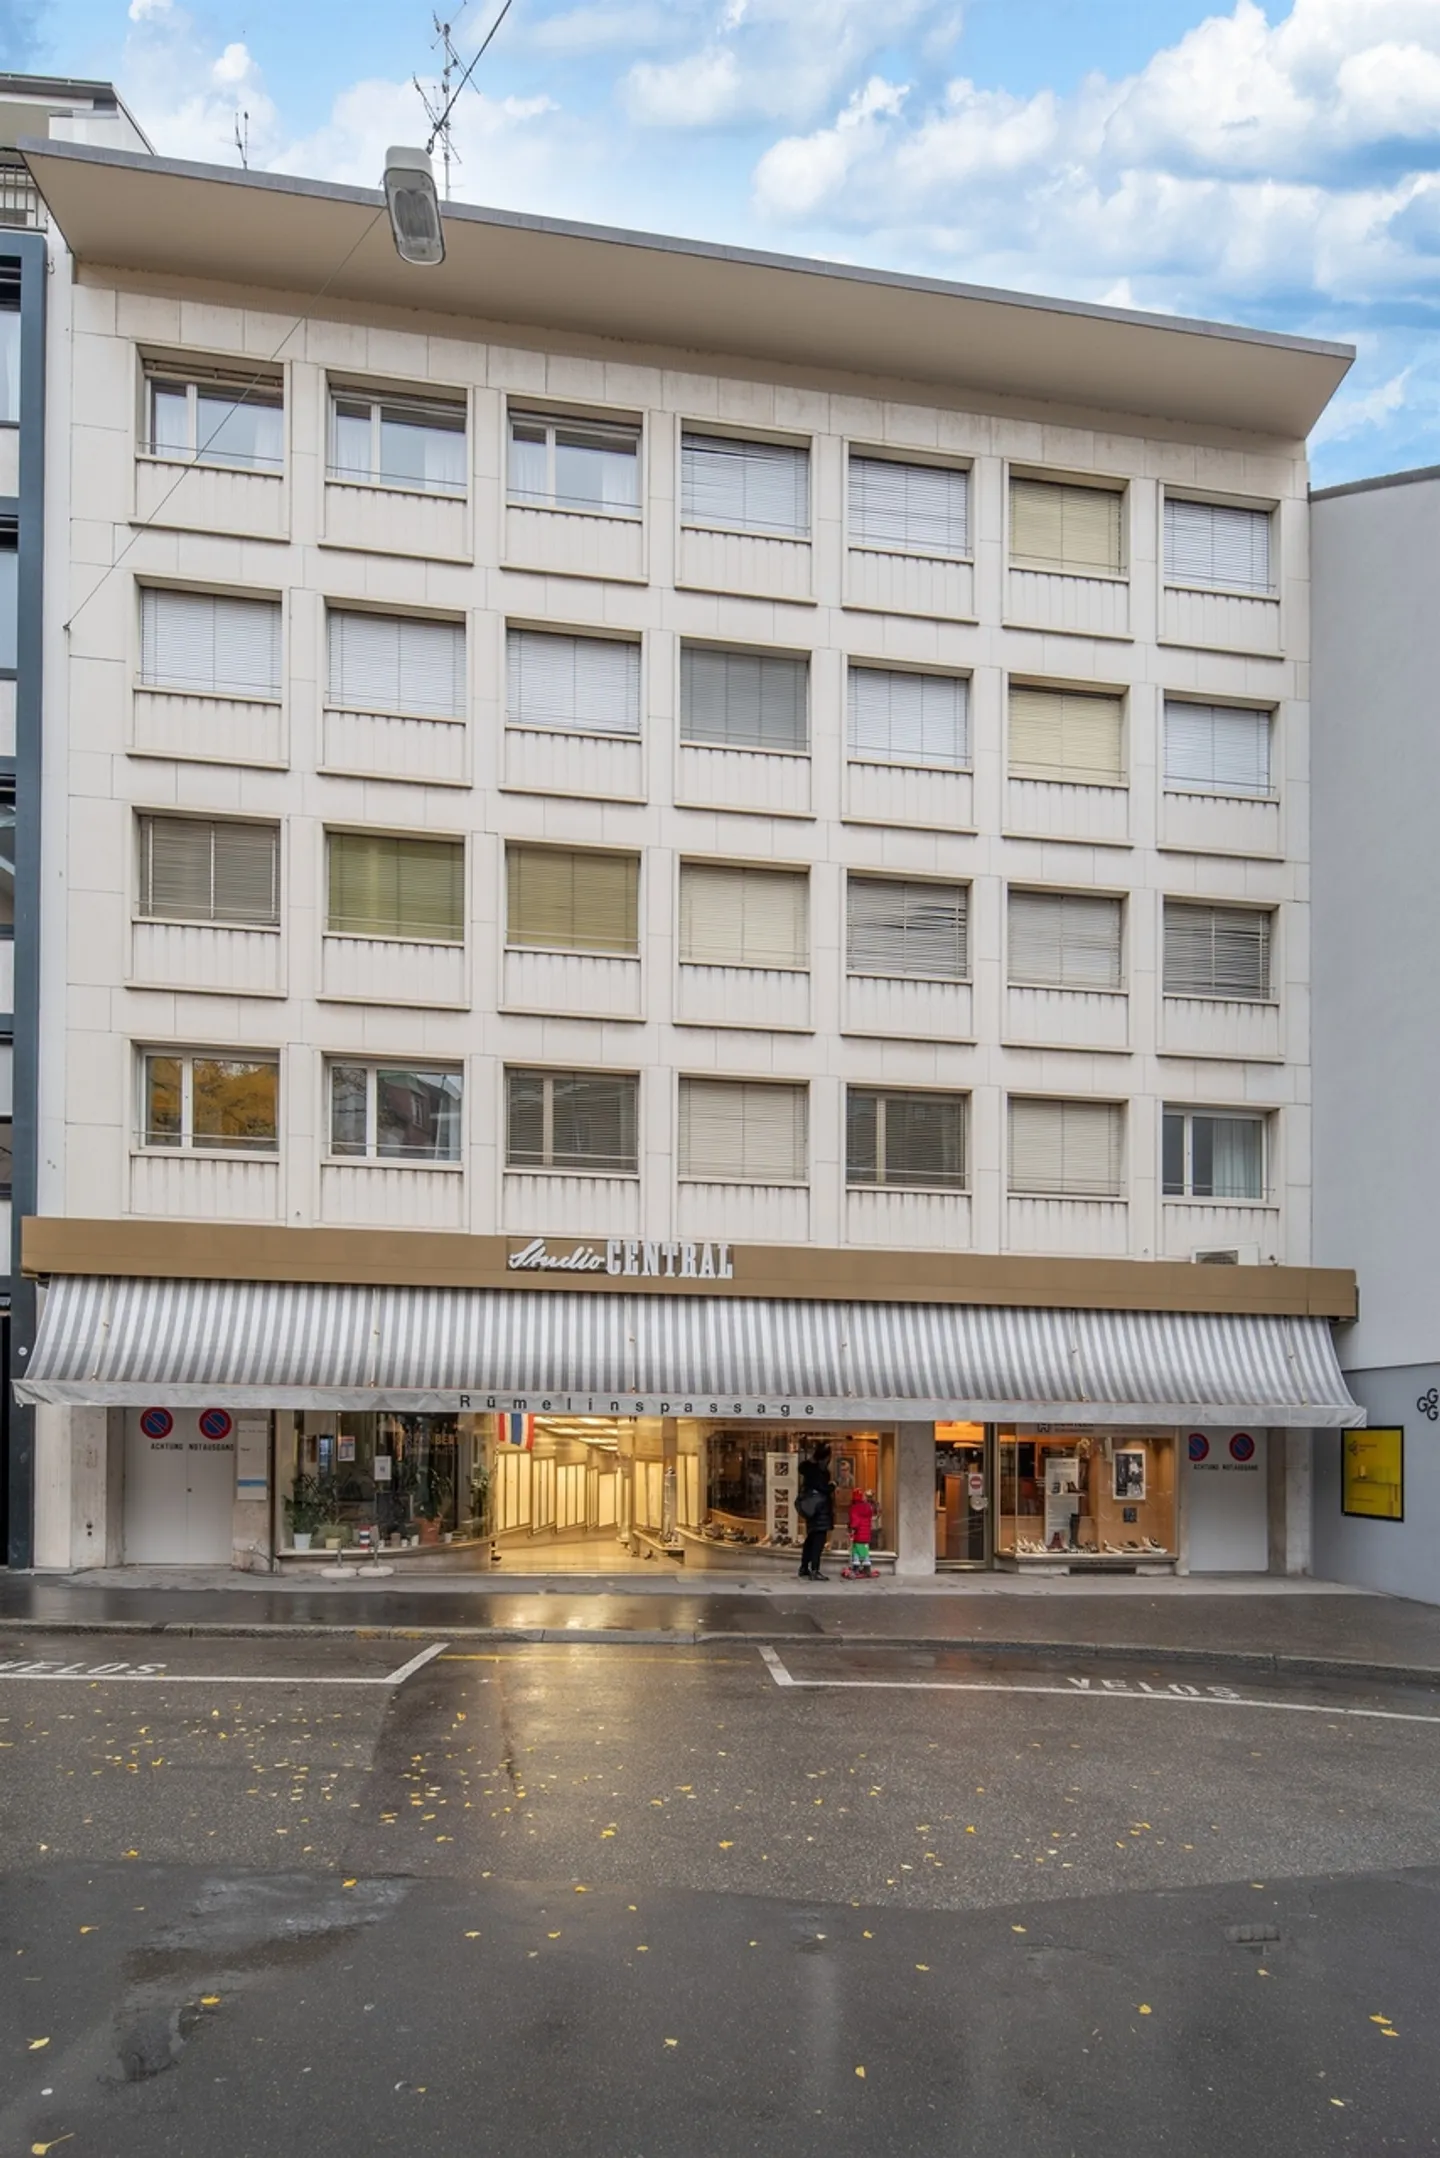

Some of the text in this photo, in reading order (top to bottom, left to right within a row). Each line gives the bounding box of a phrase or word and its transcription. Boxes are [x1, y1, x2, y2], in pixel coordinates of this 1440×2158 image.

[508, 1238, 733, 1279] Studio CENTRAL
[459, 1395, 815, 1417] Rümelinspassage
[150, 1442, 184, 1451] ACHTUNG
[188, 1443, 235, 1452] NOTAUSGANG
[0, 1660, 167, 1674] VELOS
[1067, 1677, 1240, 1699] VELOS
